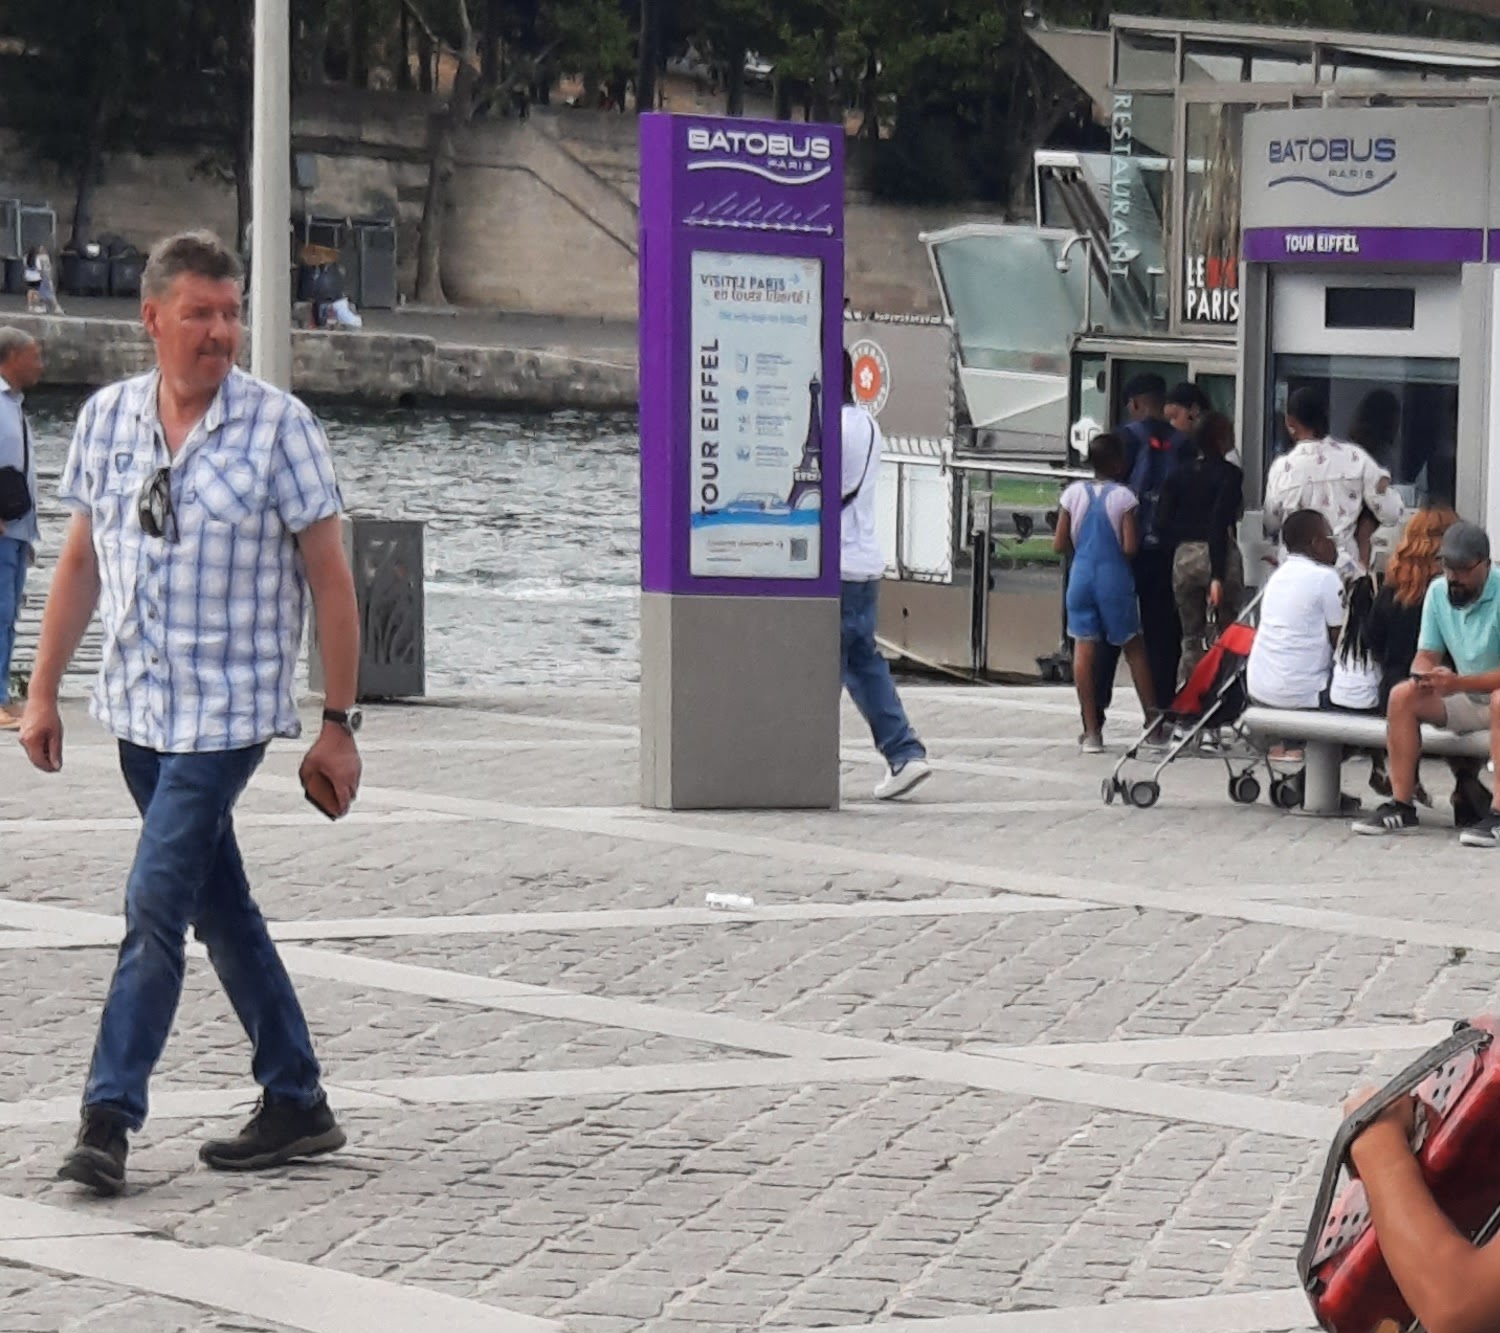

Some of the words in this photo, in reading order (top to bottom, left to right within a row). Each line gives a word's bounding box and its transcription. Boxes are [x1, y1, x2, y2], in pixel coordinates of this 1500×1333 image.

[688, 128, 831, 160] BATOBUS
[1268, 138, 1397, 163] BATOBUS
[767, 158, 813, 171] PARIS
[1328, 169, 1375, 179] PARIS
[1109, 94, 1133, 280] RESTAURANT
[1285, 233, 1315, 253] TOUR
[1316, 233, 1360, 253] EIFFEL
[700, 273, 747, 289] VISITEZ
[749, 276, 786, 291] PARIS
[1186, 256, 1205, 288] LE
[701, 338, 719, 432] EIFFEL
[701, 441, 719, 515] TOUR
